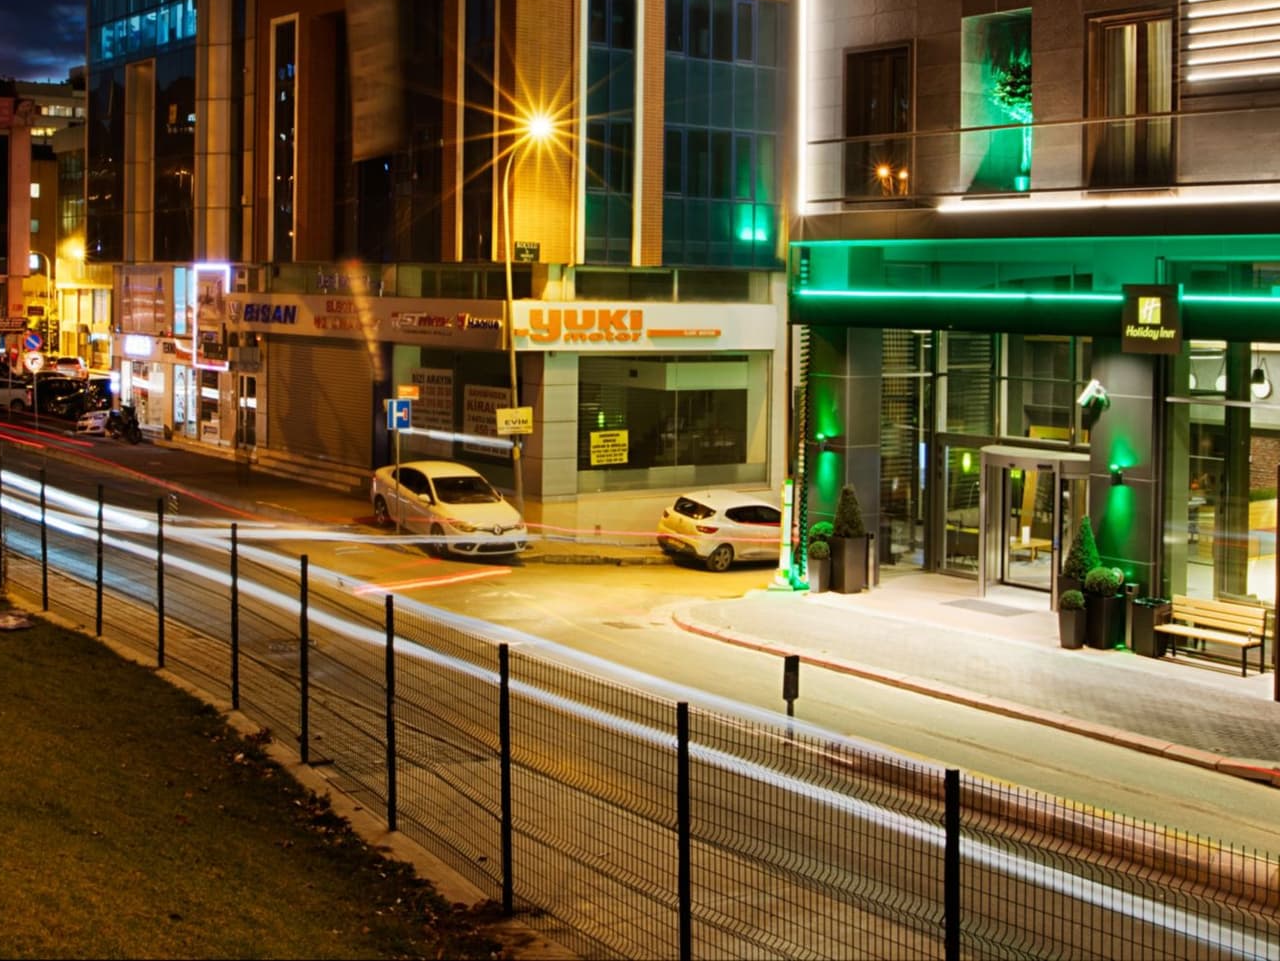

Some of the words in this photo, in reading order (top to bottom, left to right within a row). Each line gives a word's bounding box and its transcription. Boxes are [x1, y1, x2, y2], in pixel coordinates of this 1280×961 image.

[563, 330, 642, 343] motor
[1126, 325, 1160, 341] Holiday
[1160, 326, 1176, 339] Inn
